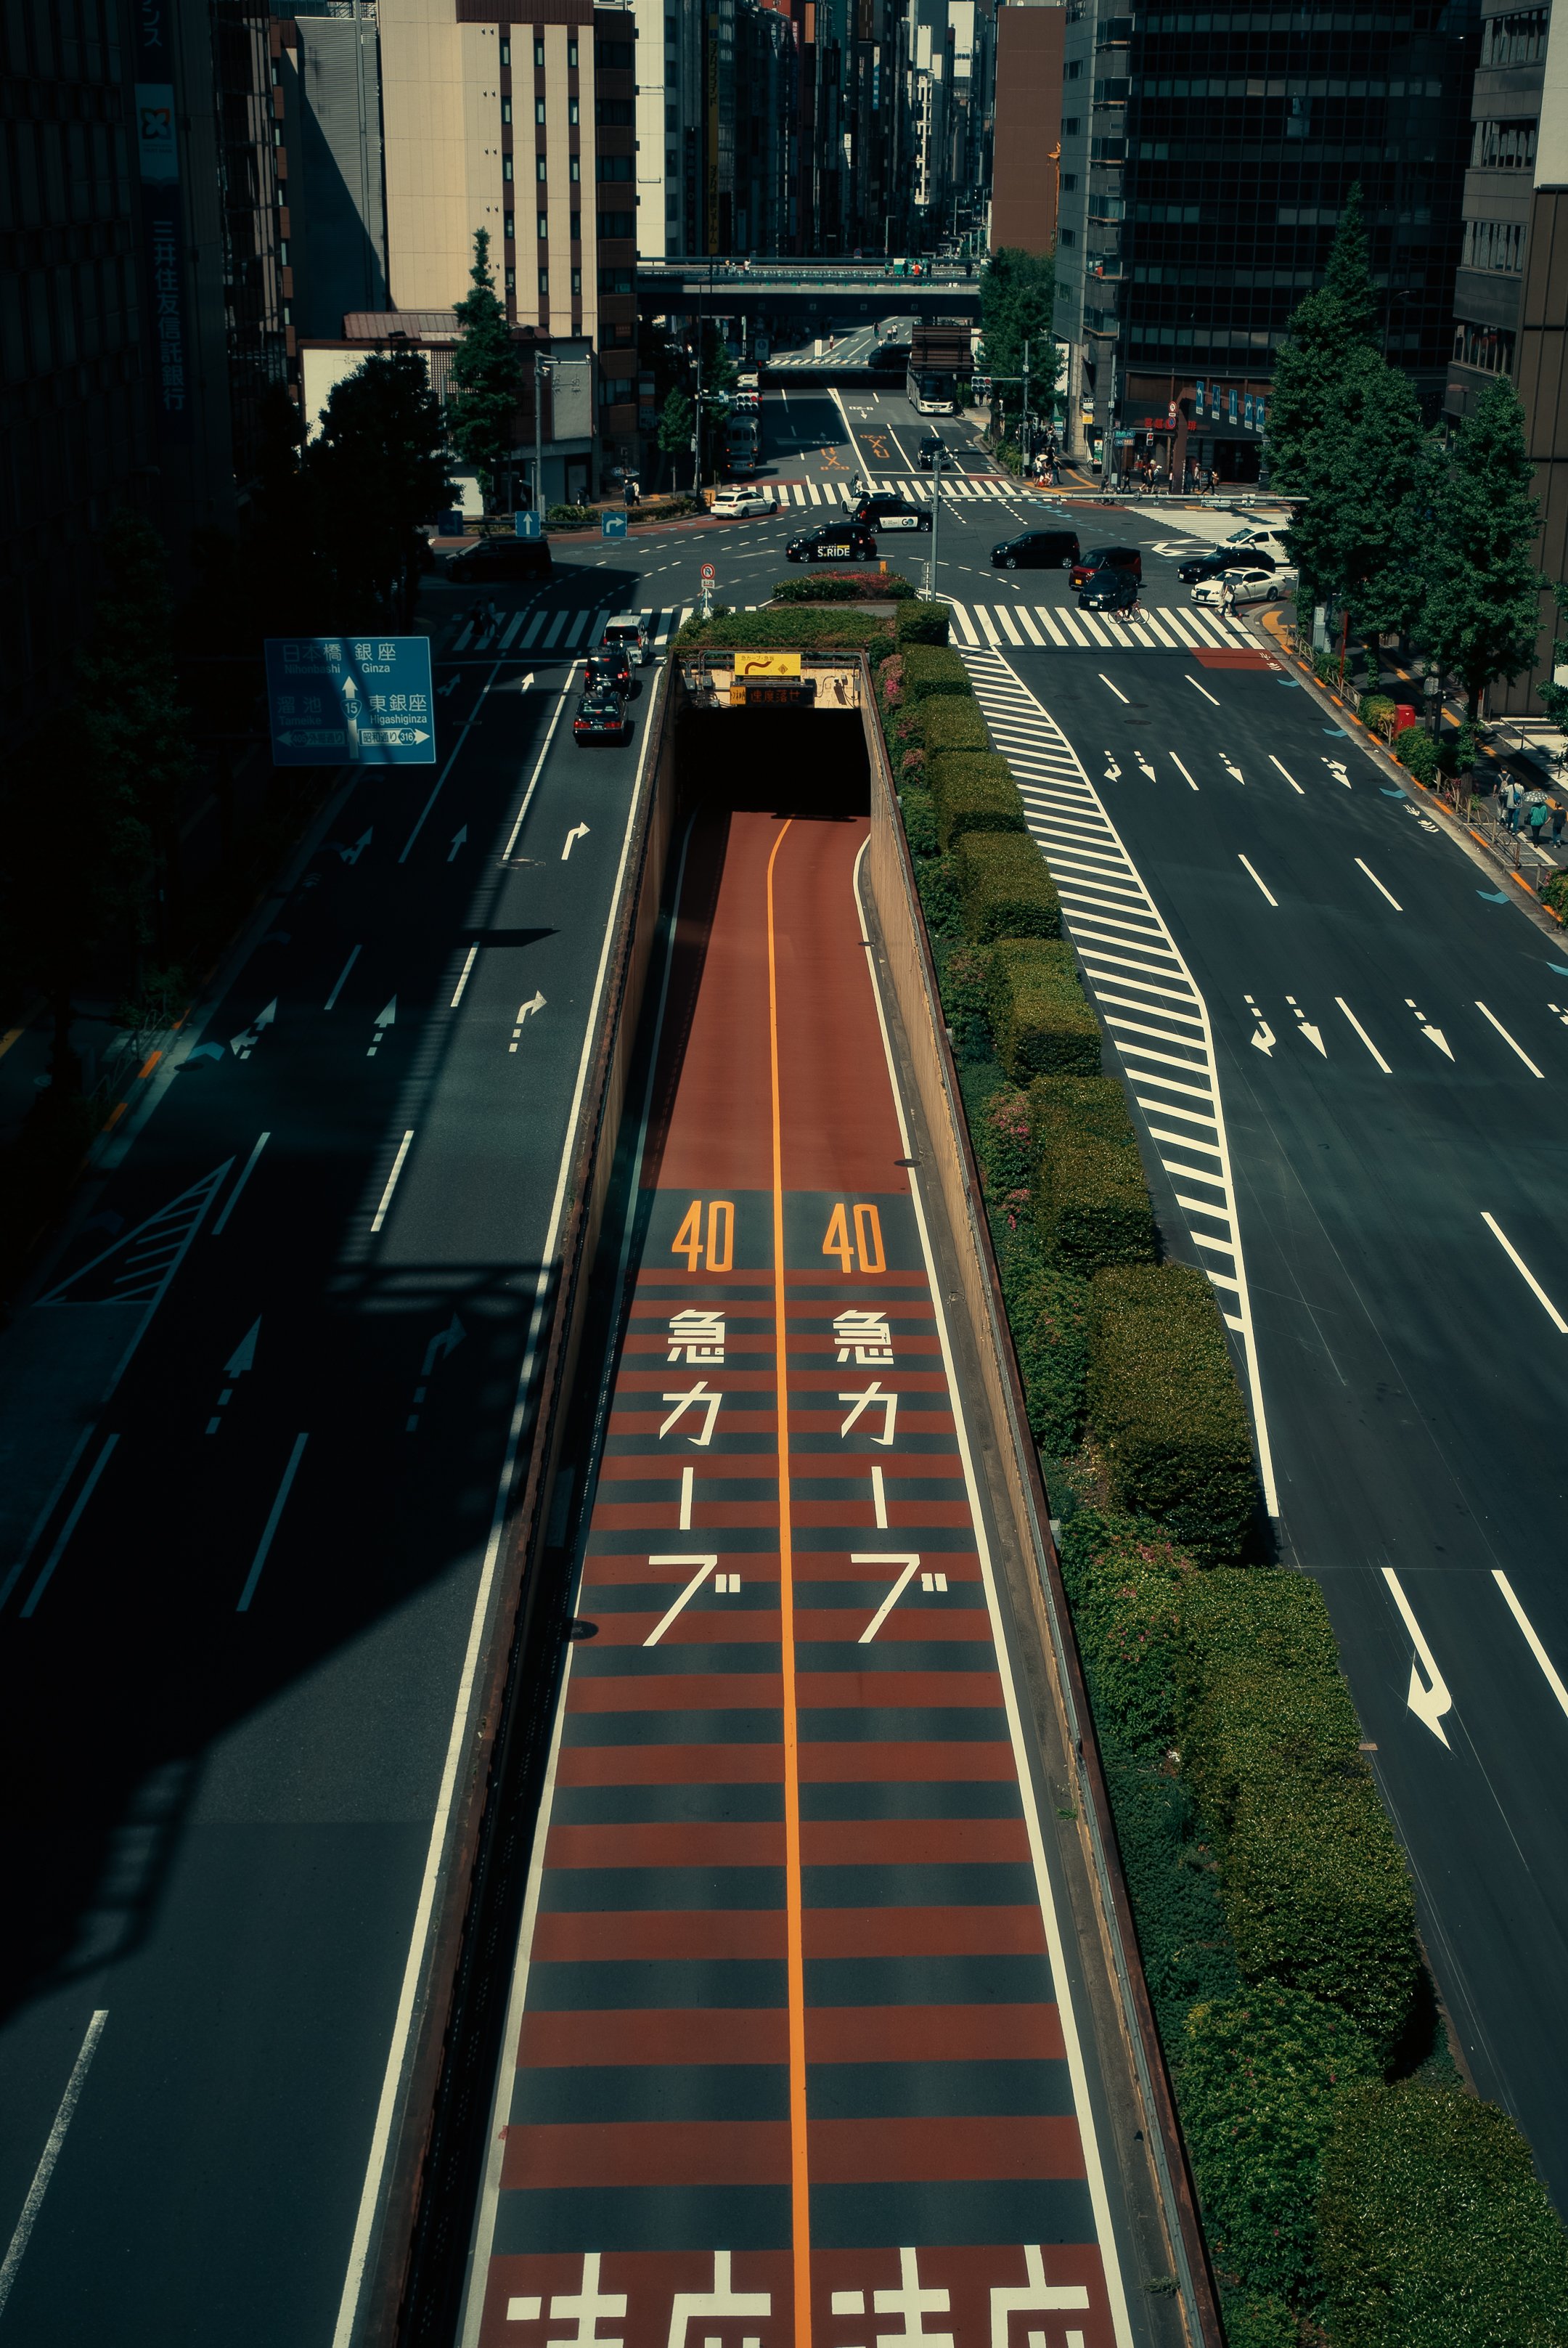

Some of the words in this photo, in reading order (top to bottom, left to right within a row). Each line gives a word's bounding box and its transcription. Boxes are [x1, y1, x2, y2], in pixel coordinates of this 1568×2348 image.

[141, 0, 163, 47] ンス
[152, 220, 185, 411] 三井住友信託銀行
[817, 547, 851, 558] S.RIDE
[283, 643, 342, 662] 日本橋
[354, 643, 396, 661] 銀座
[284, 664, 340, 674] Nihonbashi
[362, 664, 391, 674] Ginza
[277, 696, 322, 714] 溜池
[345, 702, 358, 714] 15
[368, 693, 428, 712] 東銀座
[279, 715, 322, 725] Tameike
[370, 714, 428, 726] Higashiginza
[363, 732, 397, 743] 昭和通り
[400, 732, 414, 741] 316
[671, 1201, 734, 1272] 40
[822, 1203, 886, 1273] 40
